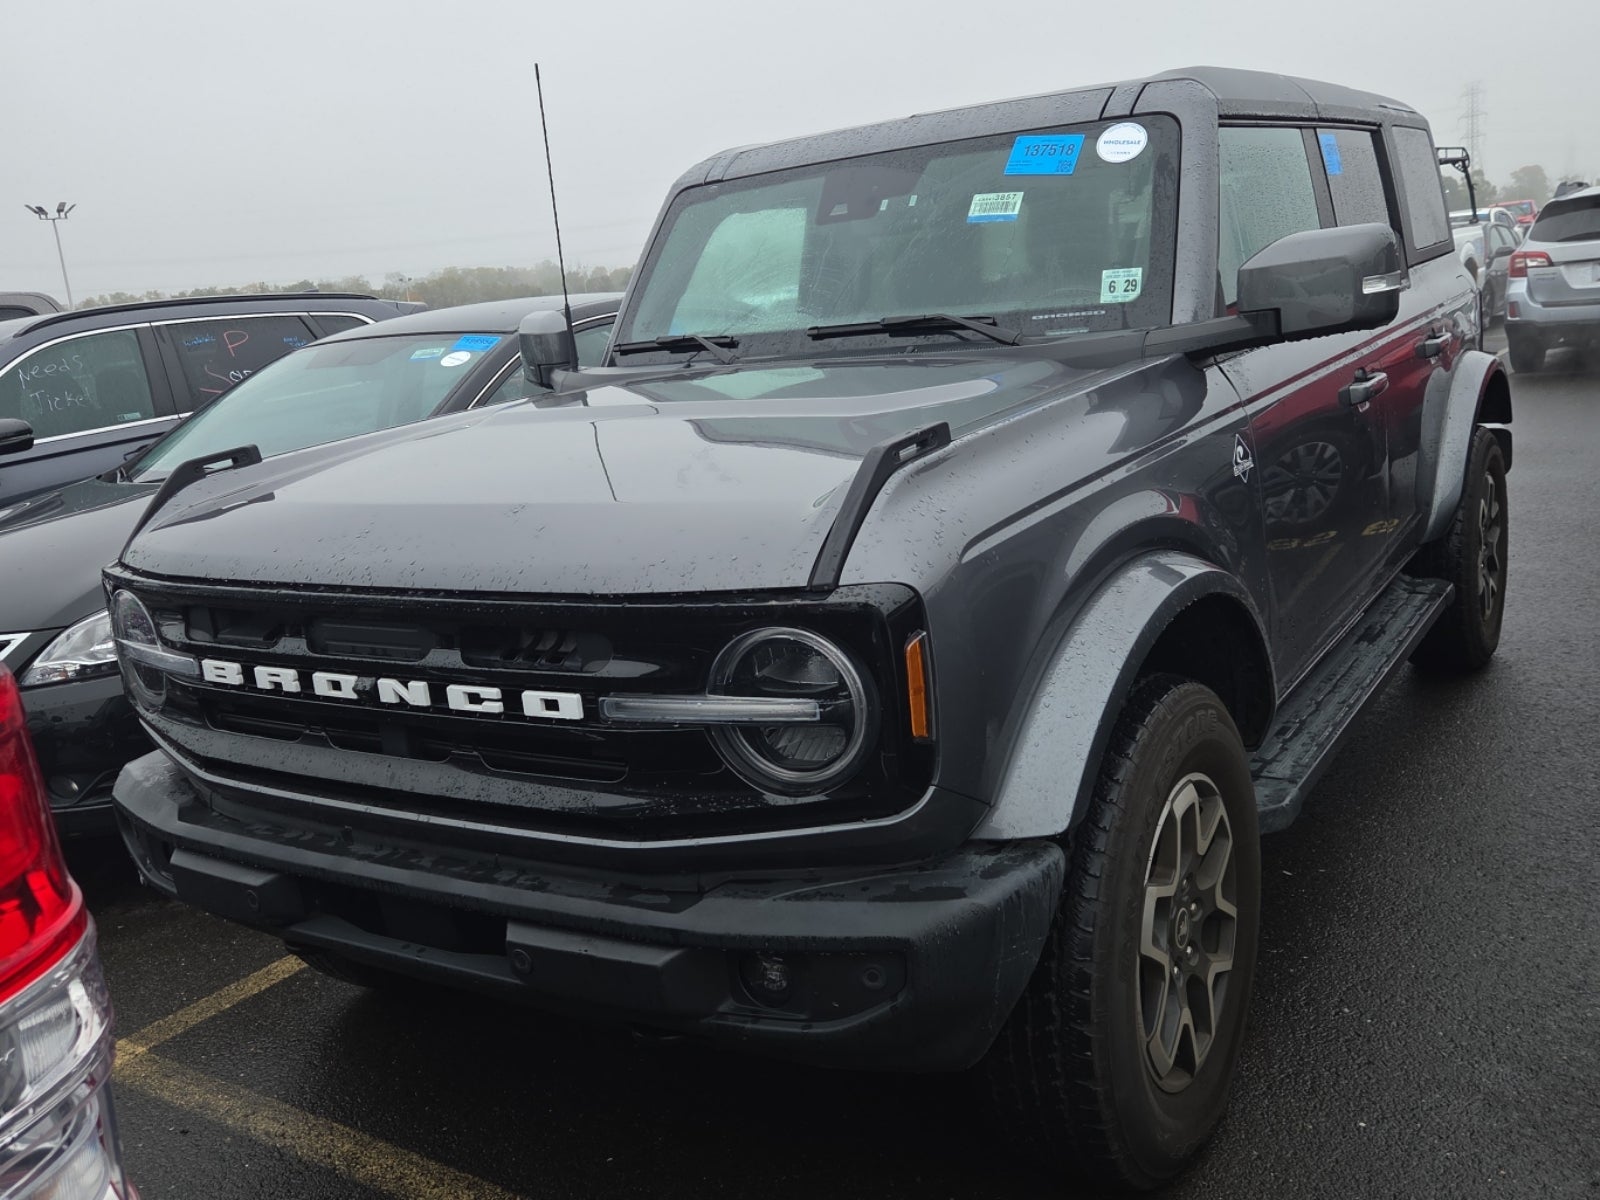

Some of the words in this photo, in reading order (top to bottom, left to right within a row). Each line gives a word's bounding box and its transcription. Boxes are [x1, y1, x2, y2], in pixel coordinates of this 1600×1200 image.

[1024, 143, 1076, 157] 137518
[1108, 280, 1117, 294] 6
[1123, 278, 1138, 293] 29
[223, 330, 249, 357] P
[18, 354, 84, 389] Needs
[201, 658, 585, 721] BRONCO
